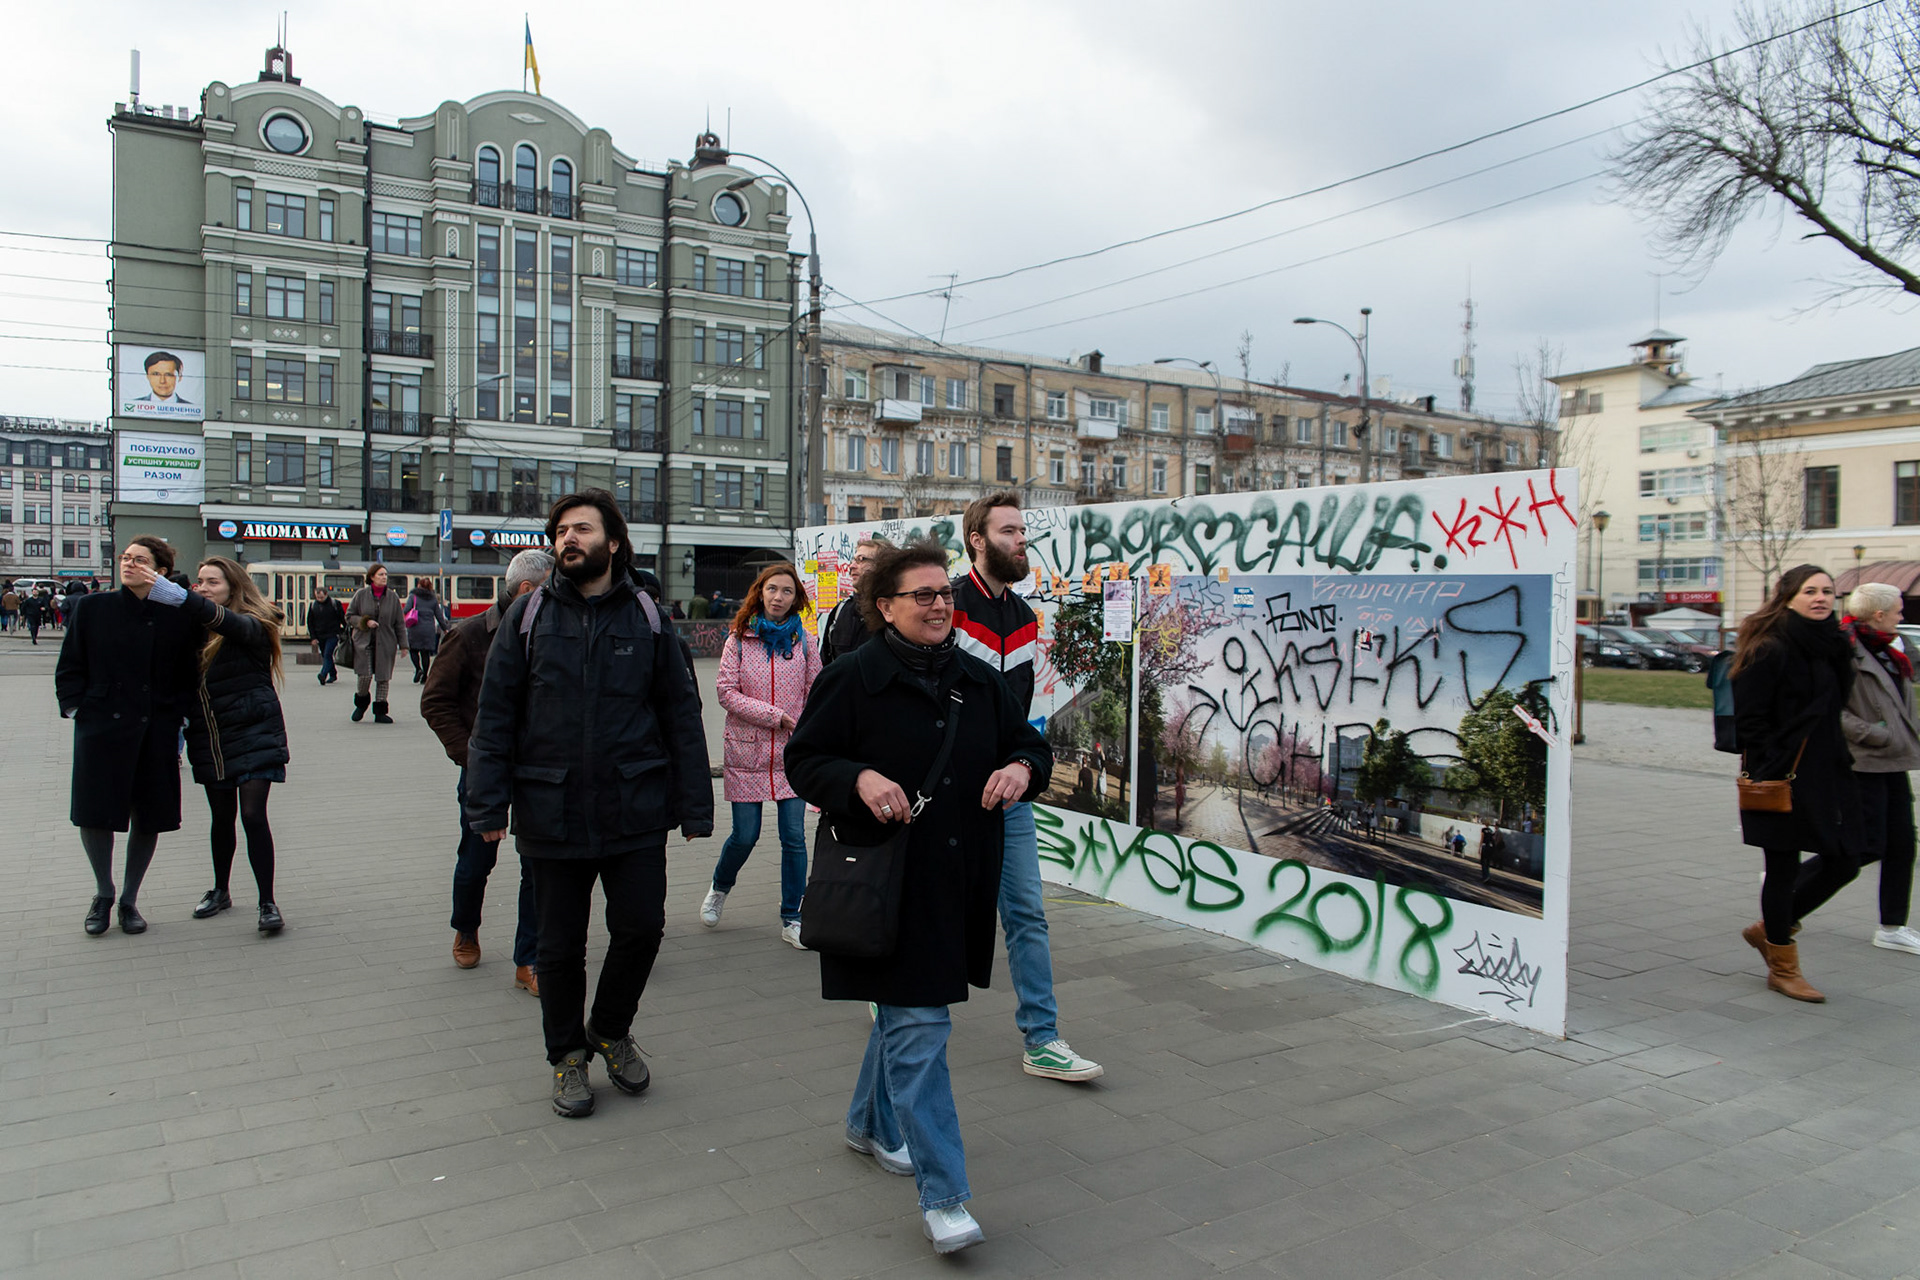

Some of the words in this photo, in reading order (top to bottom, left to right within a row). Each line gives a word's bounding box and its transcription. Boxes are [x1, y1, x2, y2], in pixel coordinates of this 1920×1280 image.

[157, 405, 201, 414] ШЕВЧЕНКО
[130, 444, 196, 455] ПОБУДУЄМО
[127, 458, 164, 466] УСПІШНУ
[164, 459, 198, 469] УКРАЇНУ
[144, 471, 182, 480] РАЗОМ
[243, 524, 302, 537] AROMA
[306, 526, 348, 540] KAVA
[491, 533, 540, 546] AROMA
[1254, 857, 1454, 998] 2018
